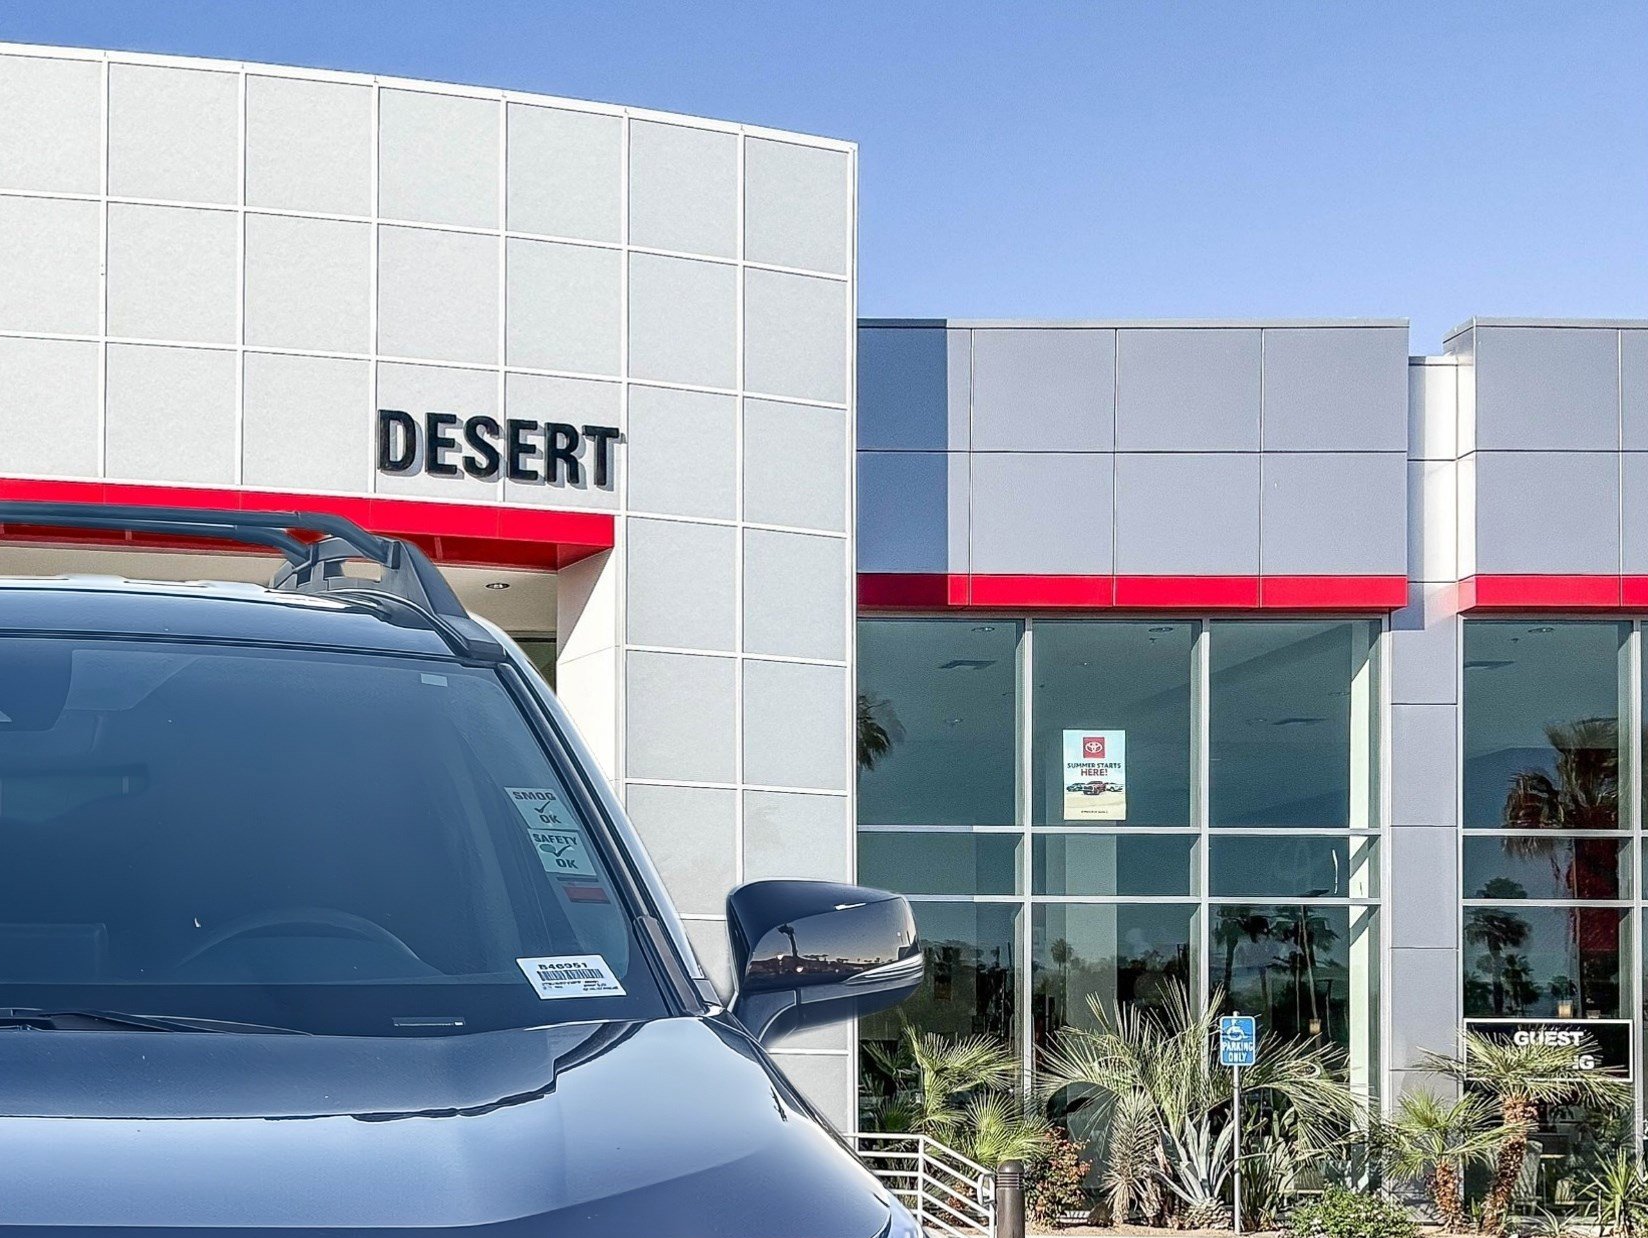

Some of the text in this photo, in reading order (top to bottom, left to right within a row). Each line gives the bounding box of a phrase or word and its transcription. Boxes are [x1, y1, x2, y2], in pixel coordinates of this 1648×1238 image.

[377, 409, 619, 486] DESERT
[513, 791, 556, 800] SMOG
[540, 815, 561, 824] OK
[533, 834, 577, 845] SAFETY
[556, 859, 578, 869] OK
[1513, 1030, 1585, 1047] GUEST
[1222, 1041, 1253, 1052] PARKING
[1228, 1052, 1247, 1062] ONLY
